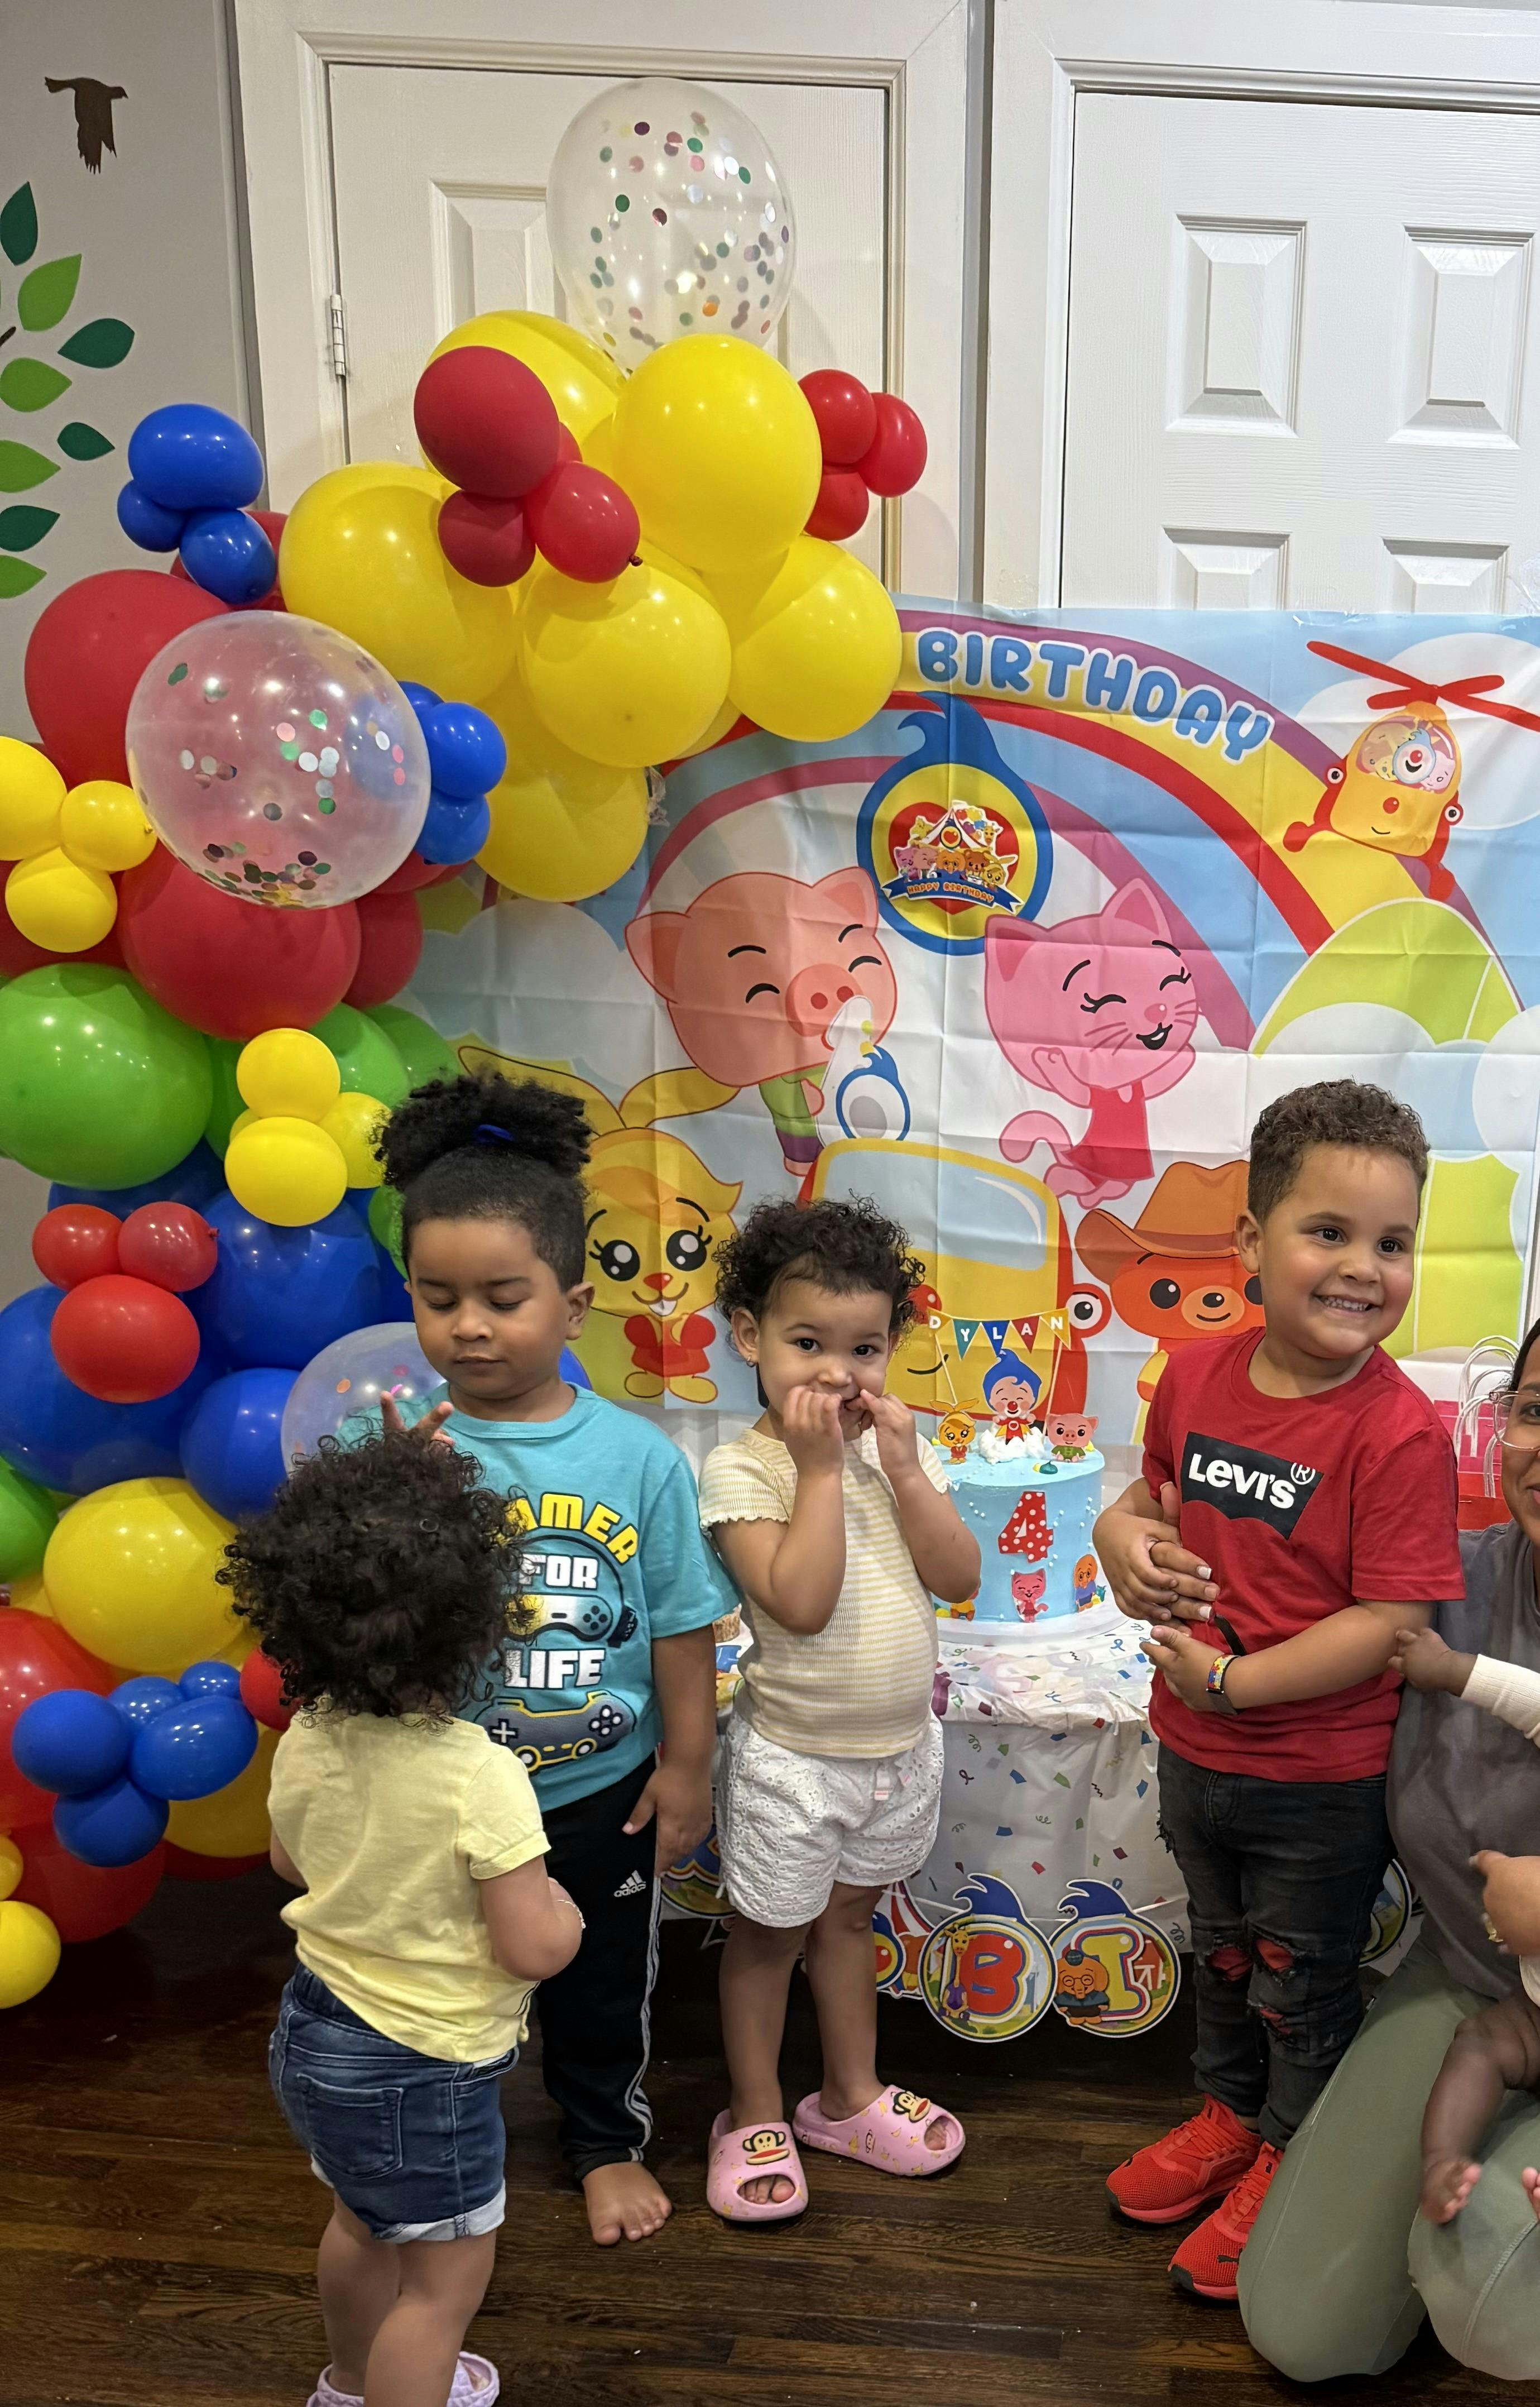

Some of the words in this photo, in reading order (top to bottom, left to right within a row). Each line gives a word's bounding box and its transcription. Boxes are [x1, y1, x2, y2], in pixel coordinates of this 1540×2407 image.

[916, 628, 1274, 763] BIRTHDAY
[907, 882, 939, 894] HAPPY
[943, 882, 994, 903] BIRTHDAY
[930, 1316, 1063, 1342] DYLAN
[492, 1492, 638, 1564] AMER
[998, 1491, 1054, 1563] 4
[518, 1554, 598, 1589] FOR
[505, 1648, 606, 1688] LIFE
